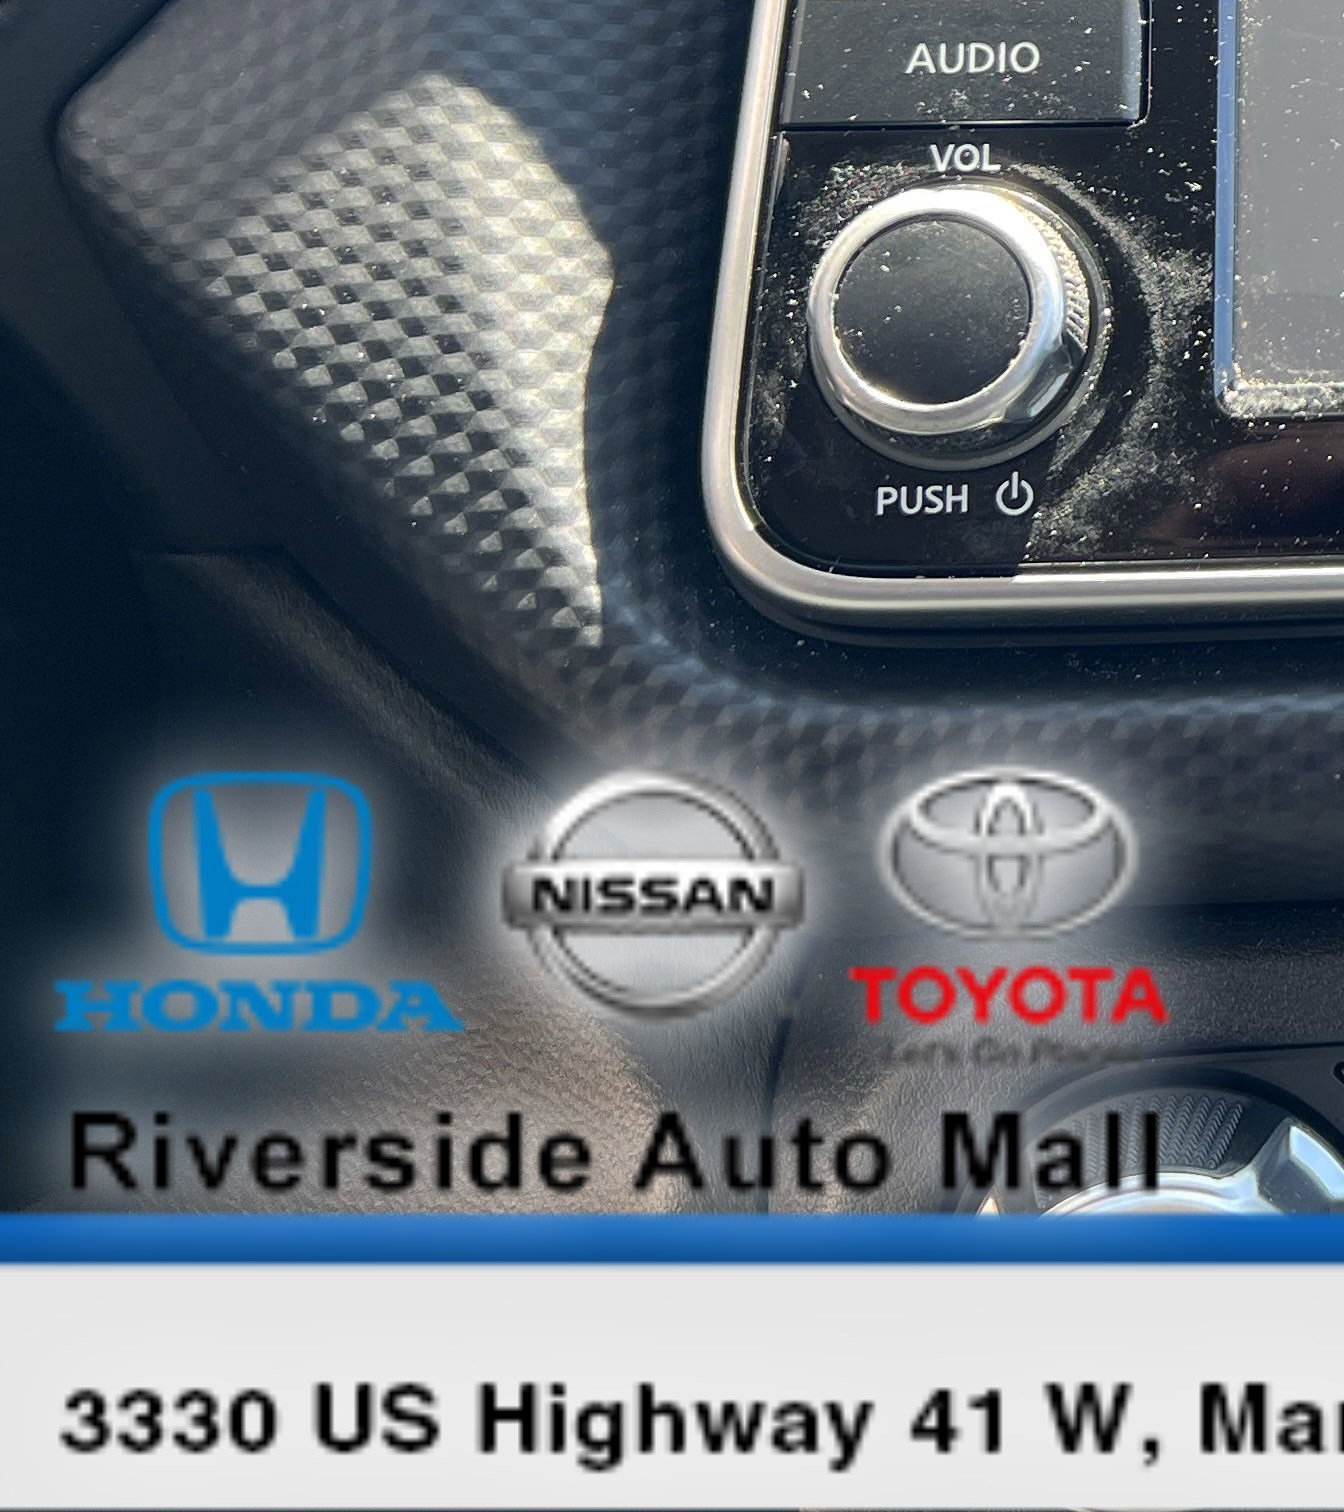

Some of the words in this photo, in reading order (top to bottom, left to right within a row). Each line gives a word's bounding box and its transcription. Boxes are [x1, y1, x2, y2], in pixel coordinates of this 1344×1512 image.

[905, 41, 1041, 74] AUDIO
[930, 143, 1000, 172] VOL
[875, 483, 969, 516] PUSH
